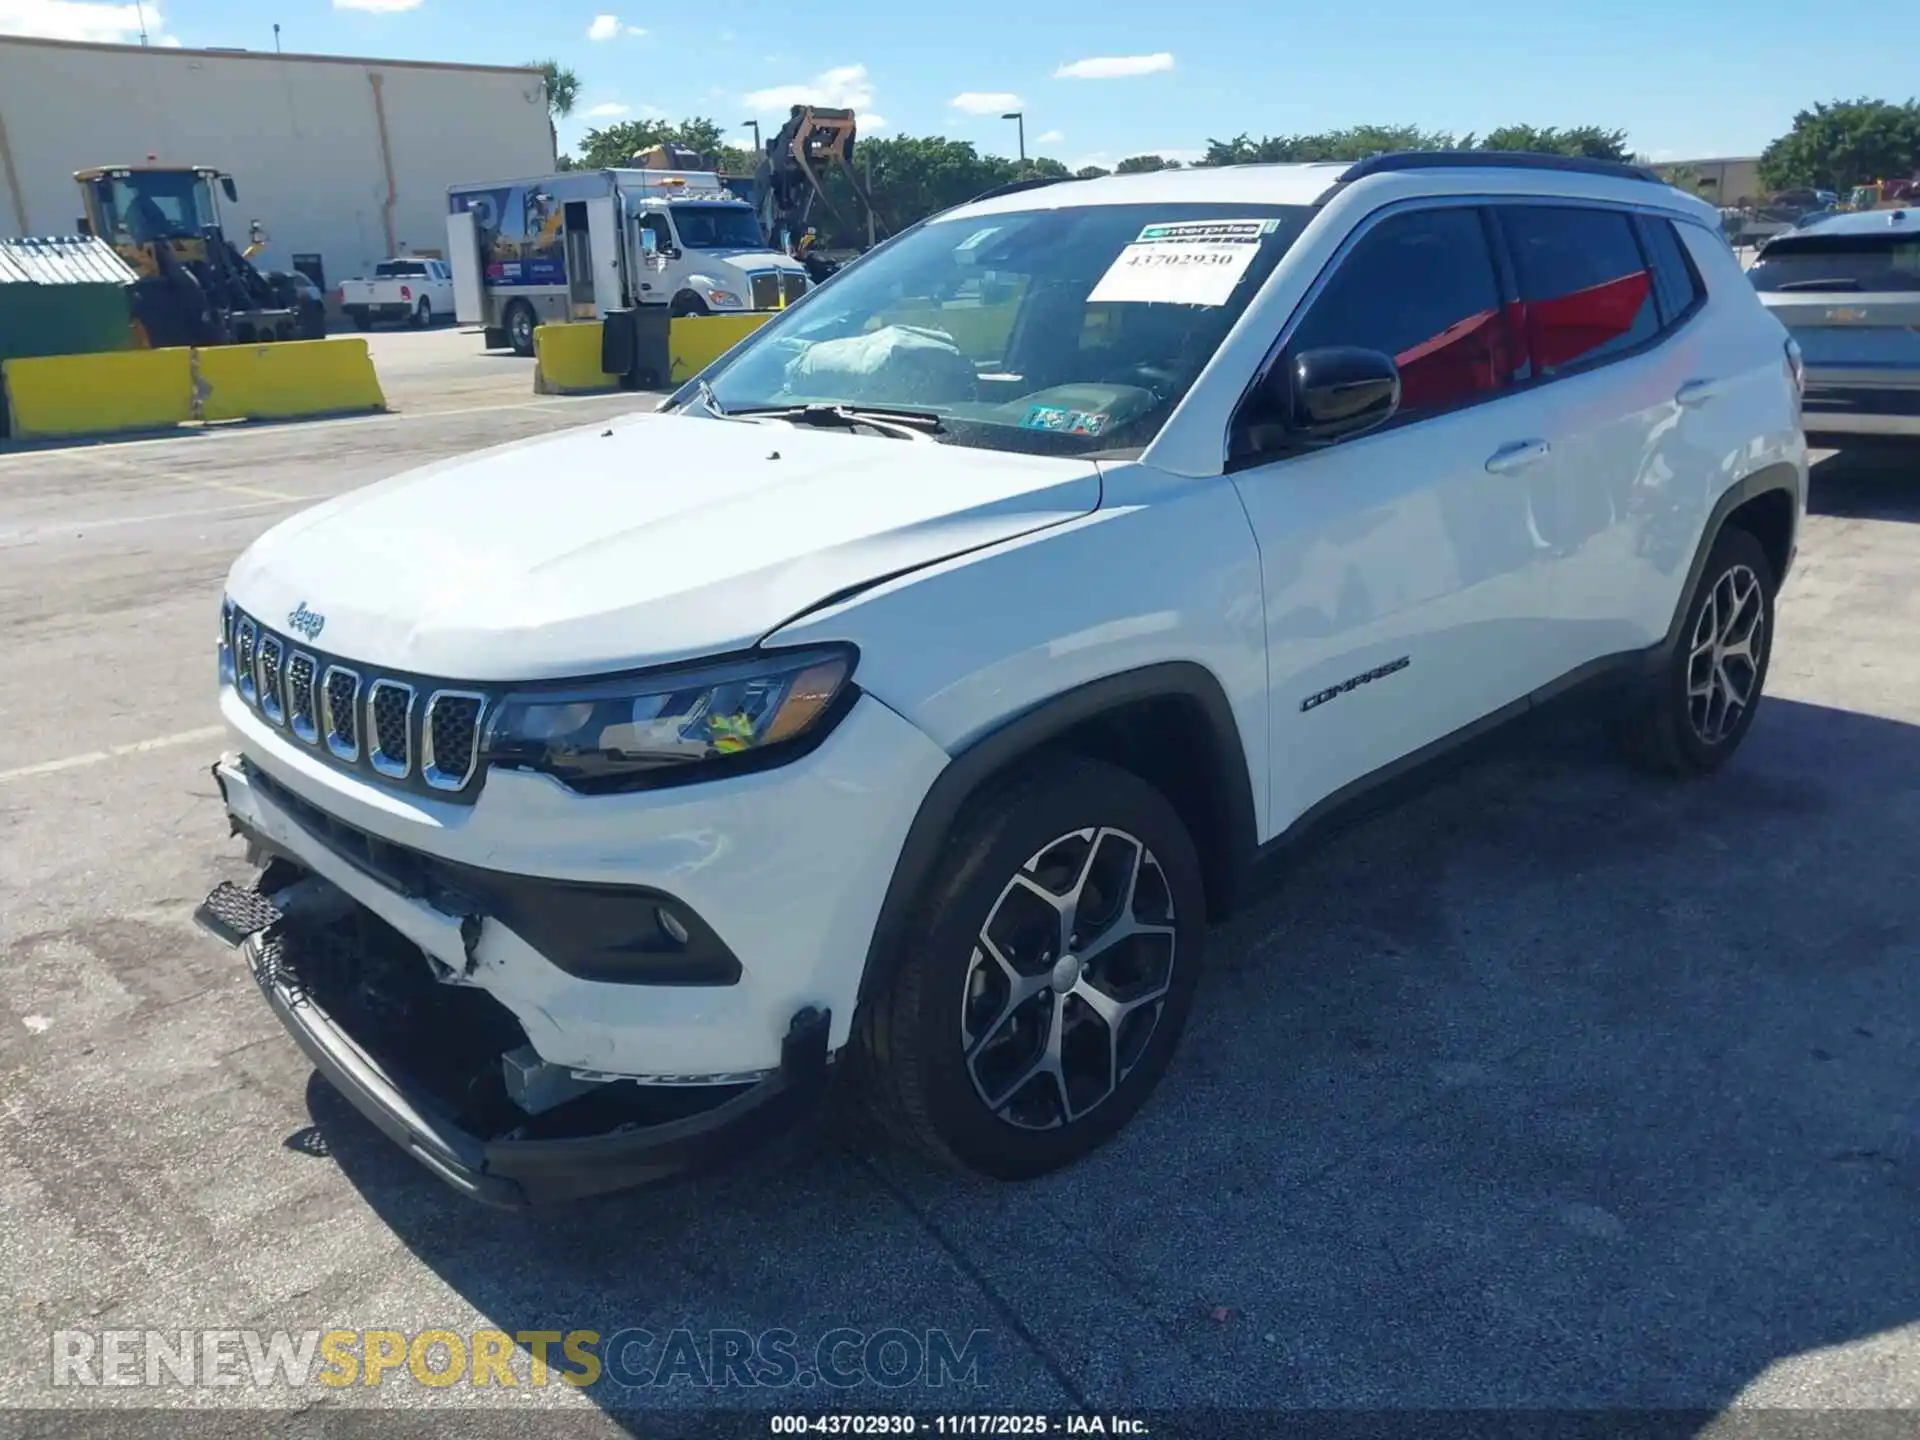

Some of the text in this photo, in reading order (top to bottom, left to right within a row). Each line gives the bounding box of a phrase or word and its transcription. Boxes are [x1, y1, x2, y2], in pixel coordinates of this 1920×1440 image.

[1126, 254, 1233, 267] 43702930
[287, 601, 325, 641] Jeep
[1300, 655, 1410, 712] COMPASS
